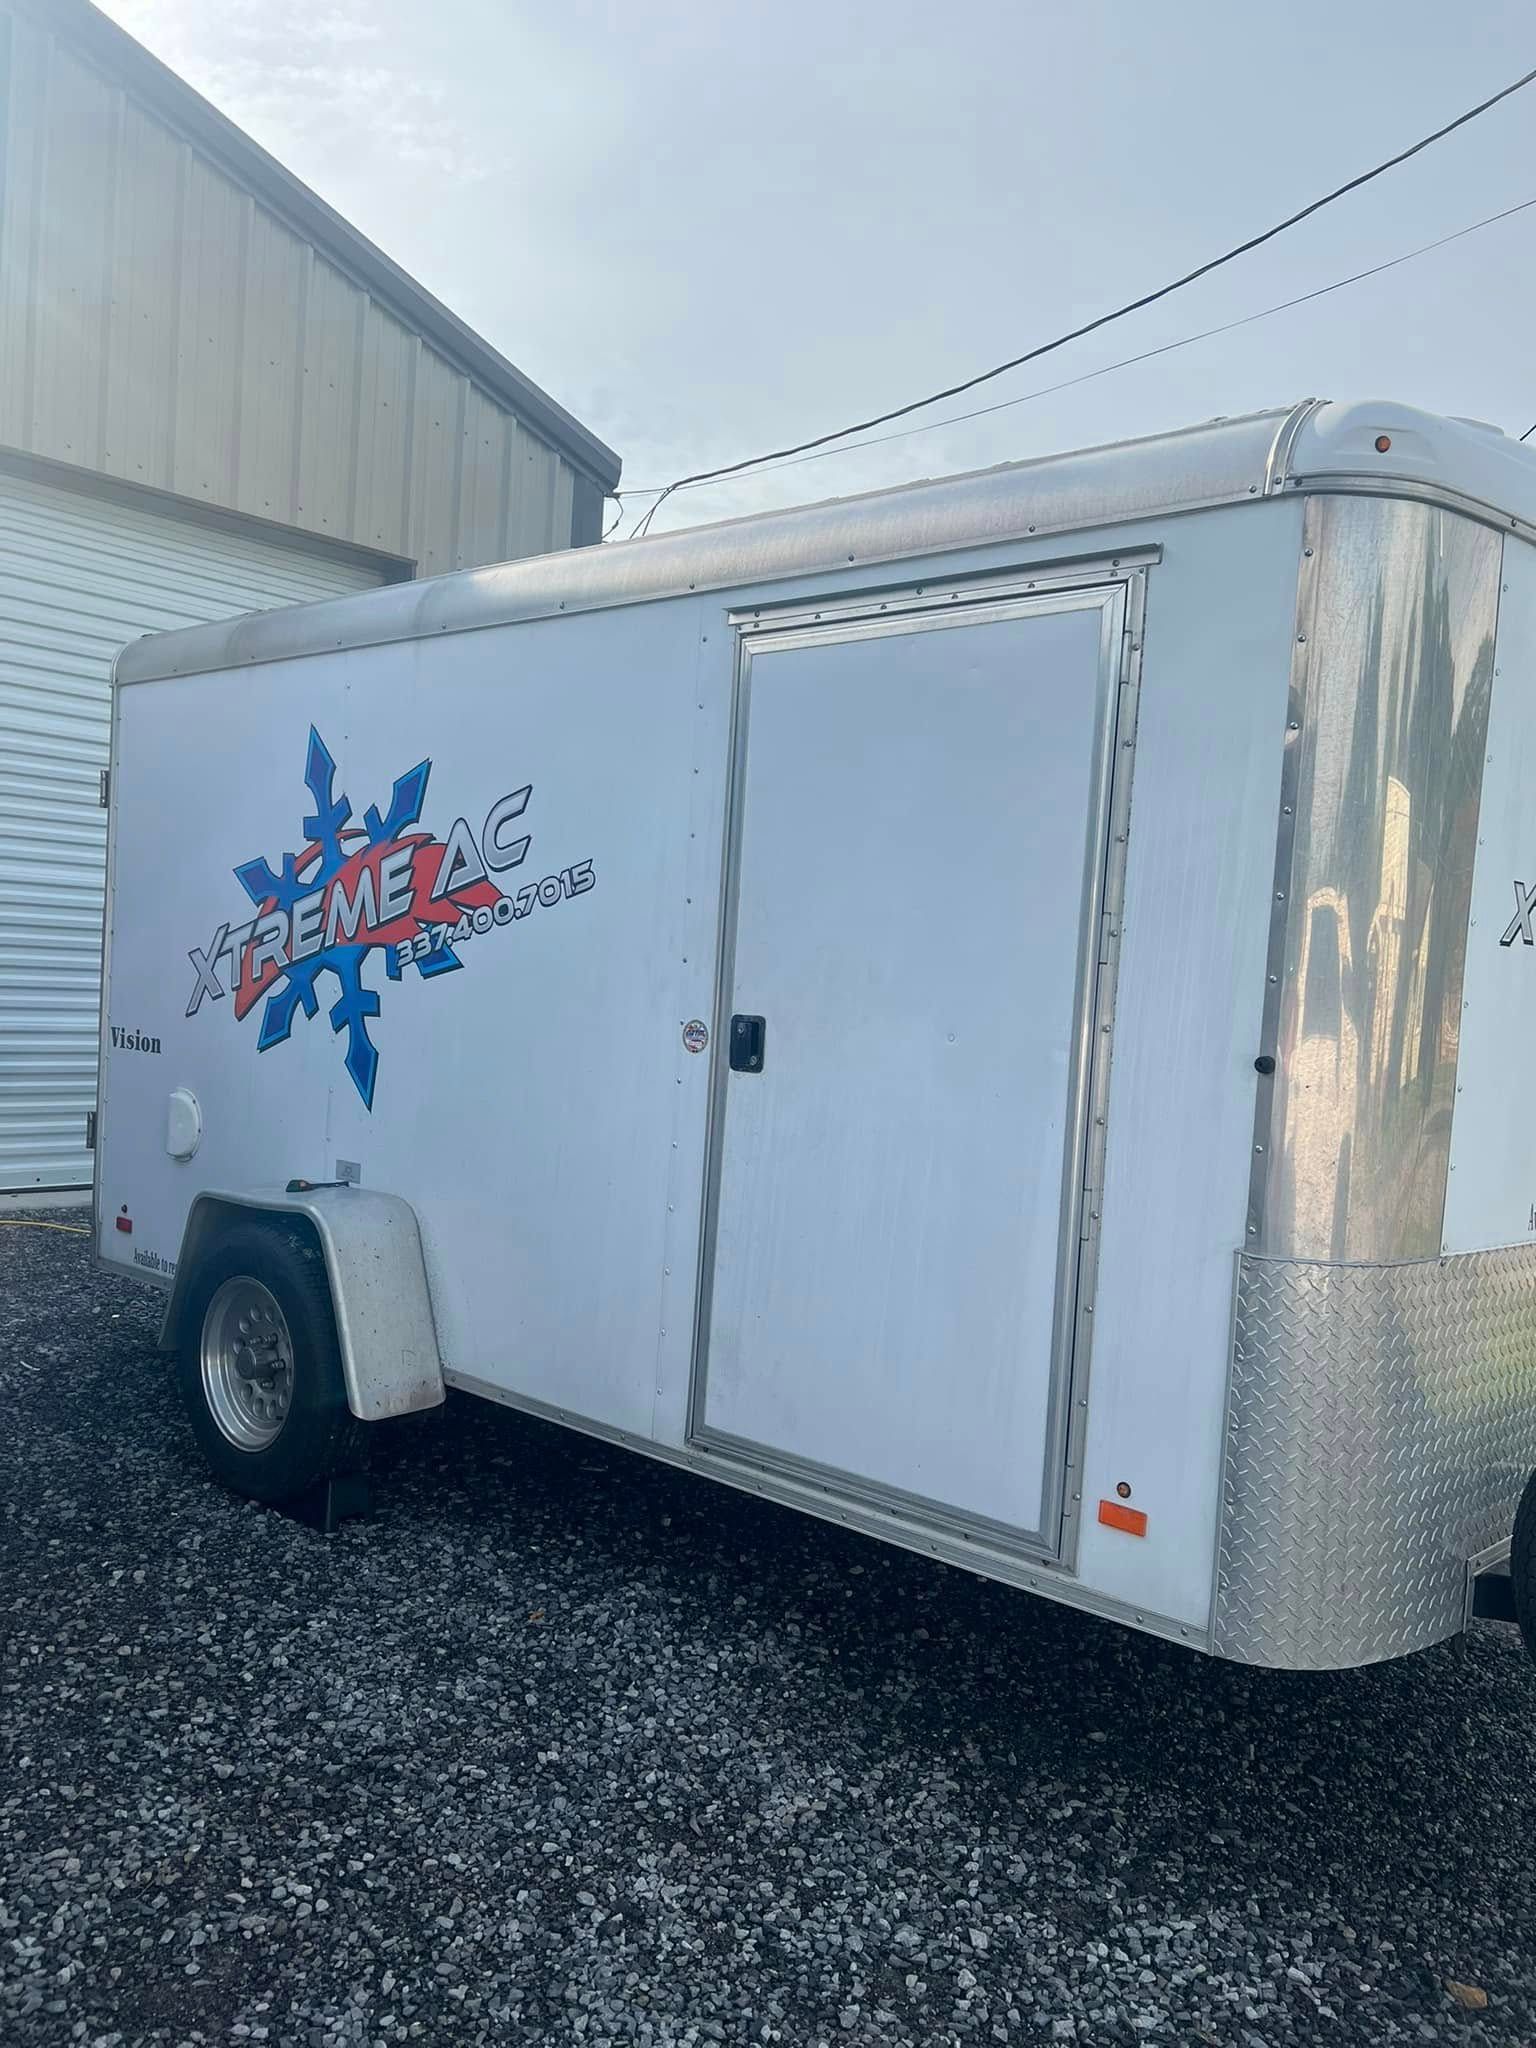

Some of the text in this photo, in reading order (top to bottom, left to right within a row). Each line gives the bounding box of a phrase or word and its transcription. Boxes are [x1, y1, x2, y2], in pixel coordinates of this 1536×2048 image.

[185, 784, 533, 1017] XTREME AC
[395, 858, 597, 967] 337.400.7015
[111, 1026, 161, 1054] Vision
